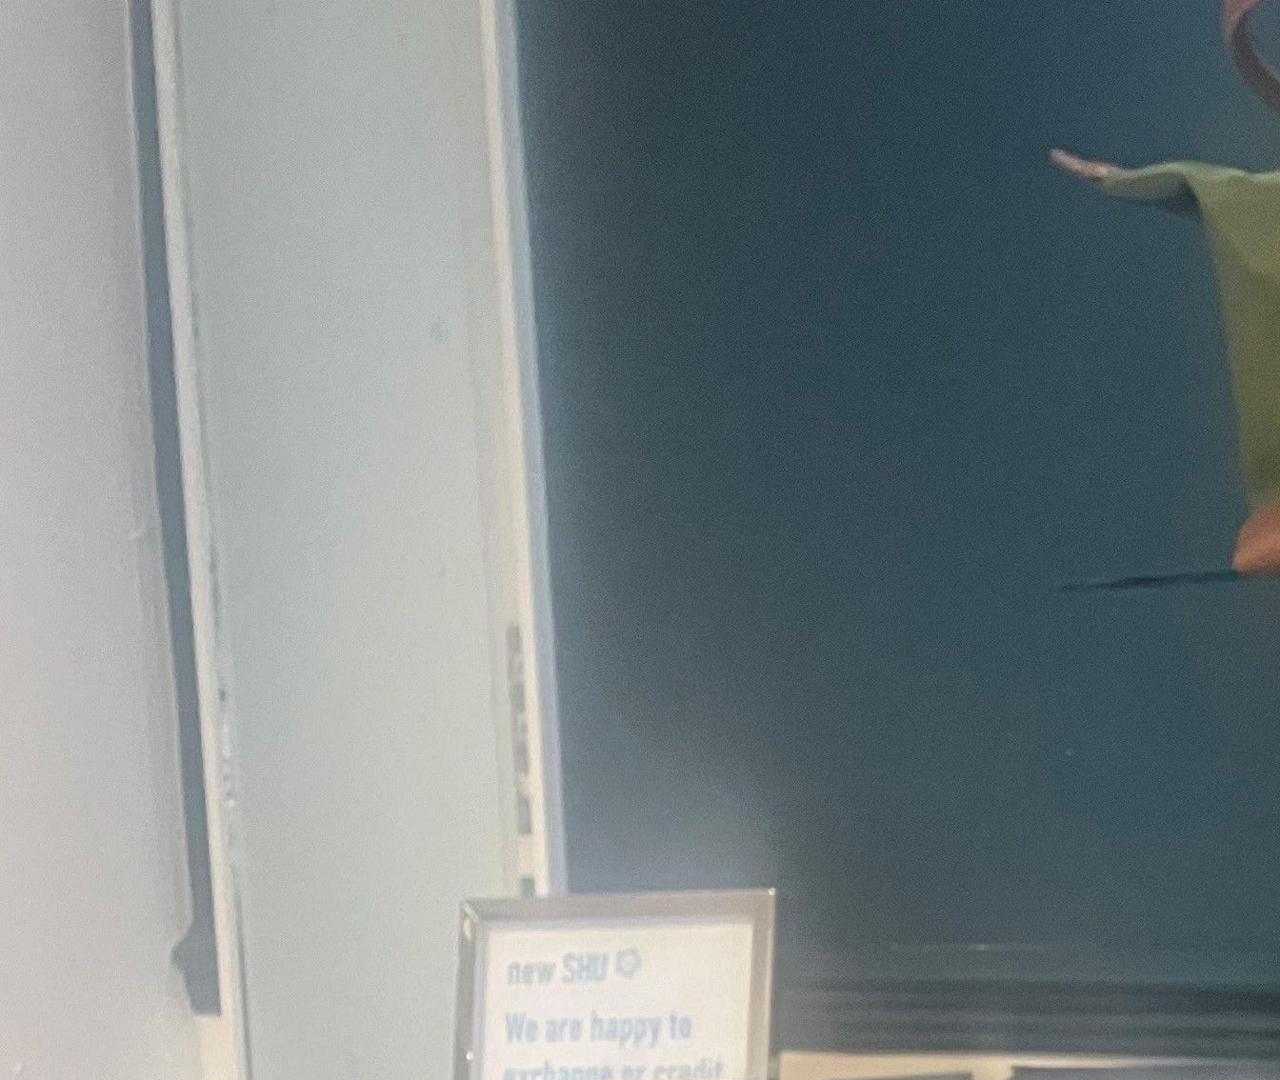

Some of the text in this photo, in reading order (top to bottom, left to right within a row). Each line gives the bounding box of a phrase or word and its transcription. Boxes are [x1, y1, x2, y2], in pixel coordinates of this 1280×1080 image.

[507, 951, 609, 985] new SHU
[505, 1009, 693, 1048] We are happy to
[652, 1057, 724, 1080] credit
